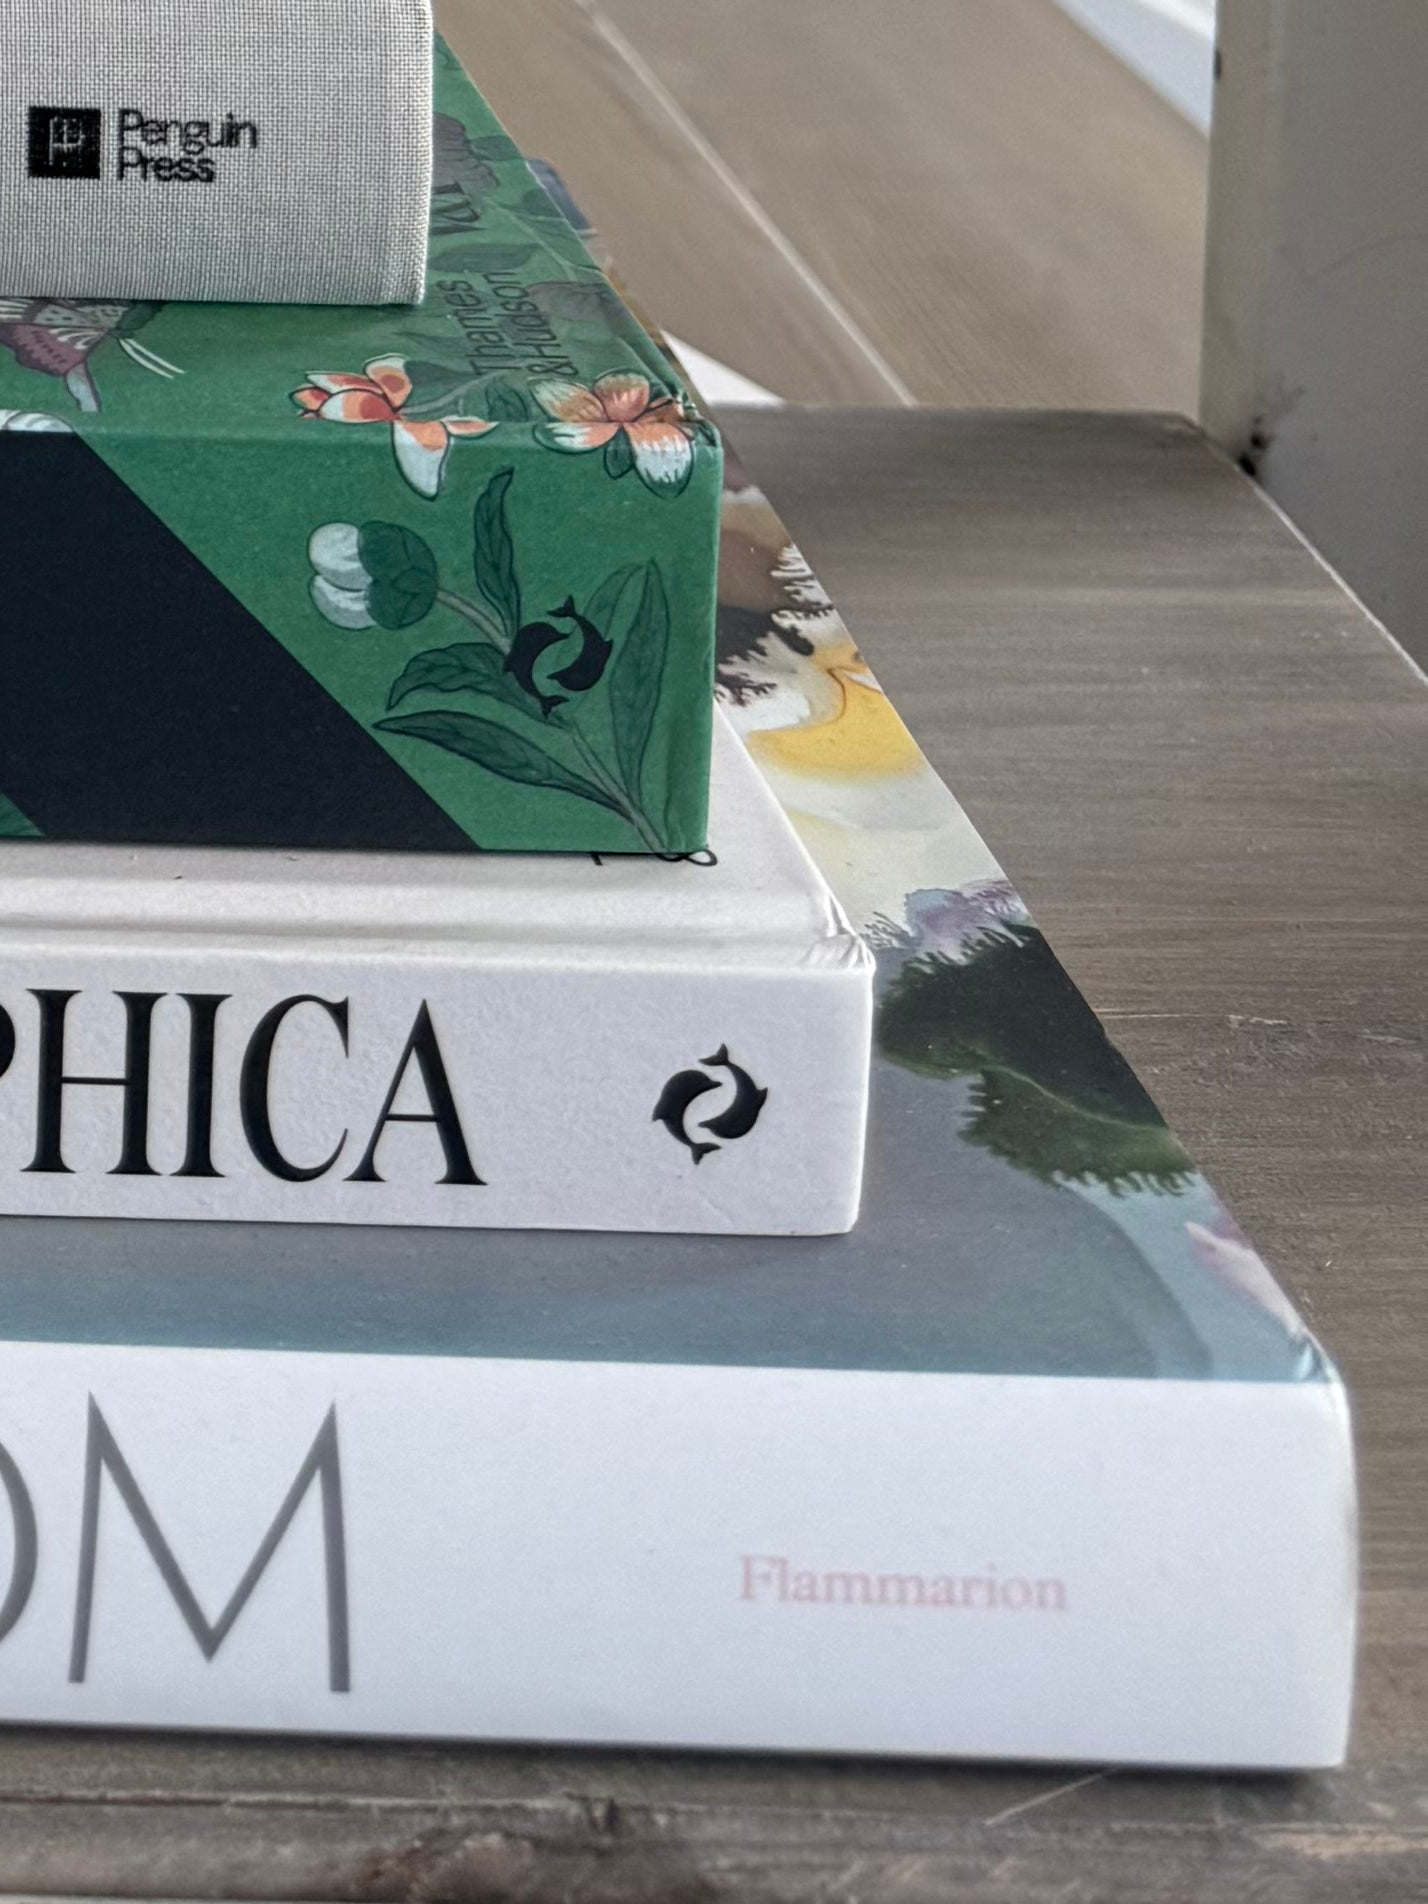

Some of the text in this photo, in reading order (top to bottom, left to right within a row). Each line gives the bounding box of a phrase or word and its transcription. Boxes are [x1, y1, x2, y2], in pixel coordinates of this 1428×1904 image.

[117, 107, 258, 155] Penguin
[116, 145, 217, 183] Press
[436, 278, 523, 376] Thames
[739, 1553, 1068, 1612] Flammarion
